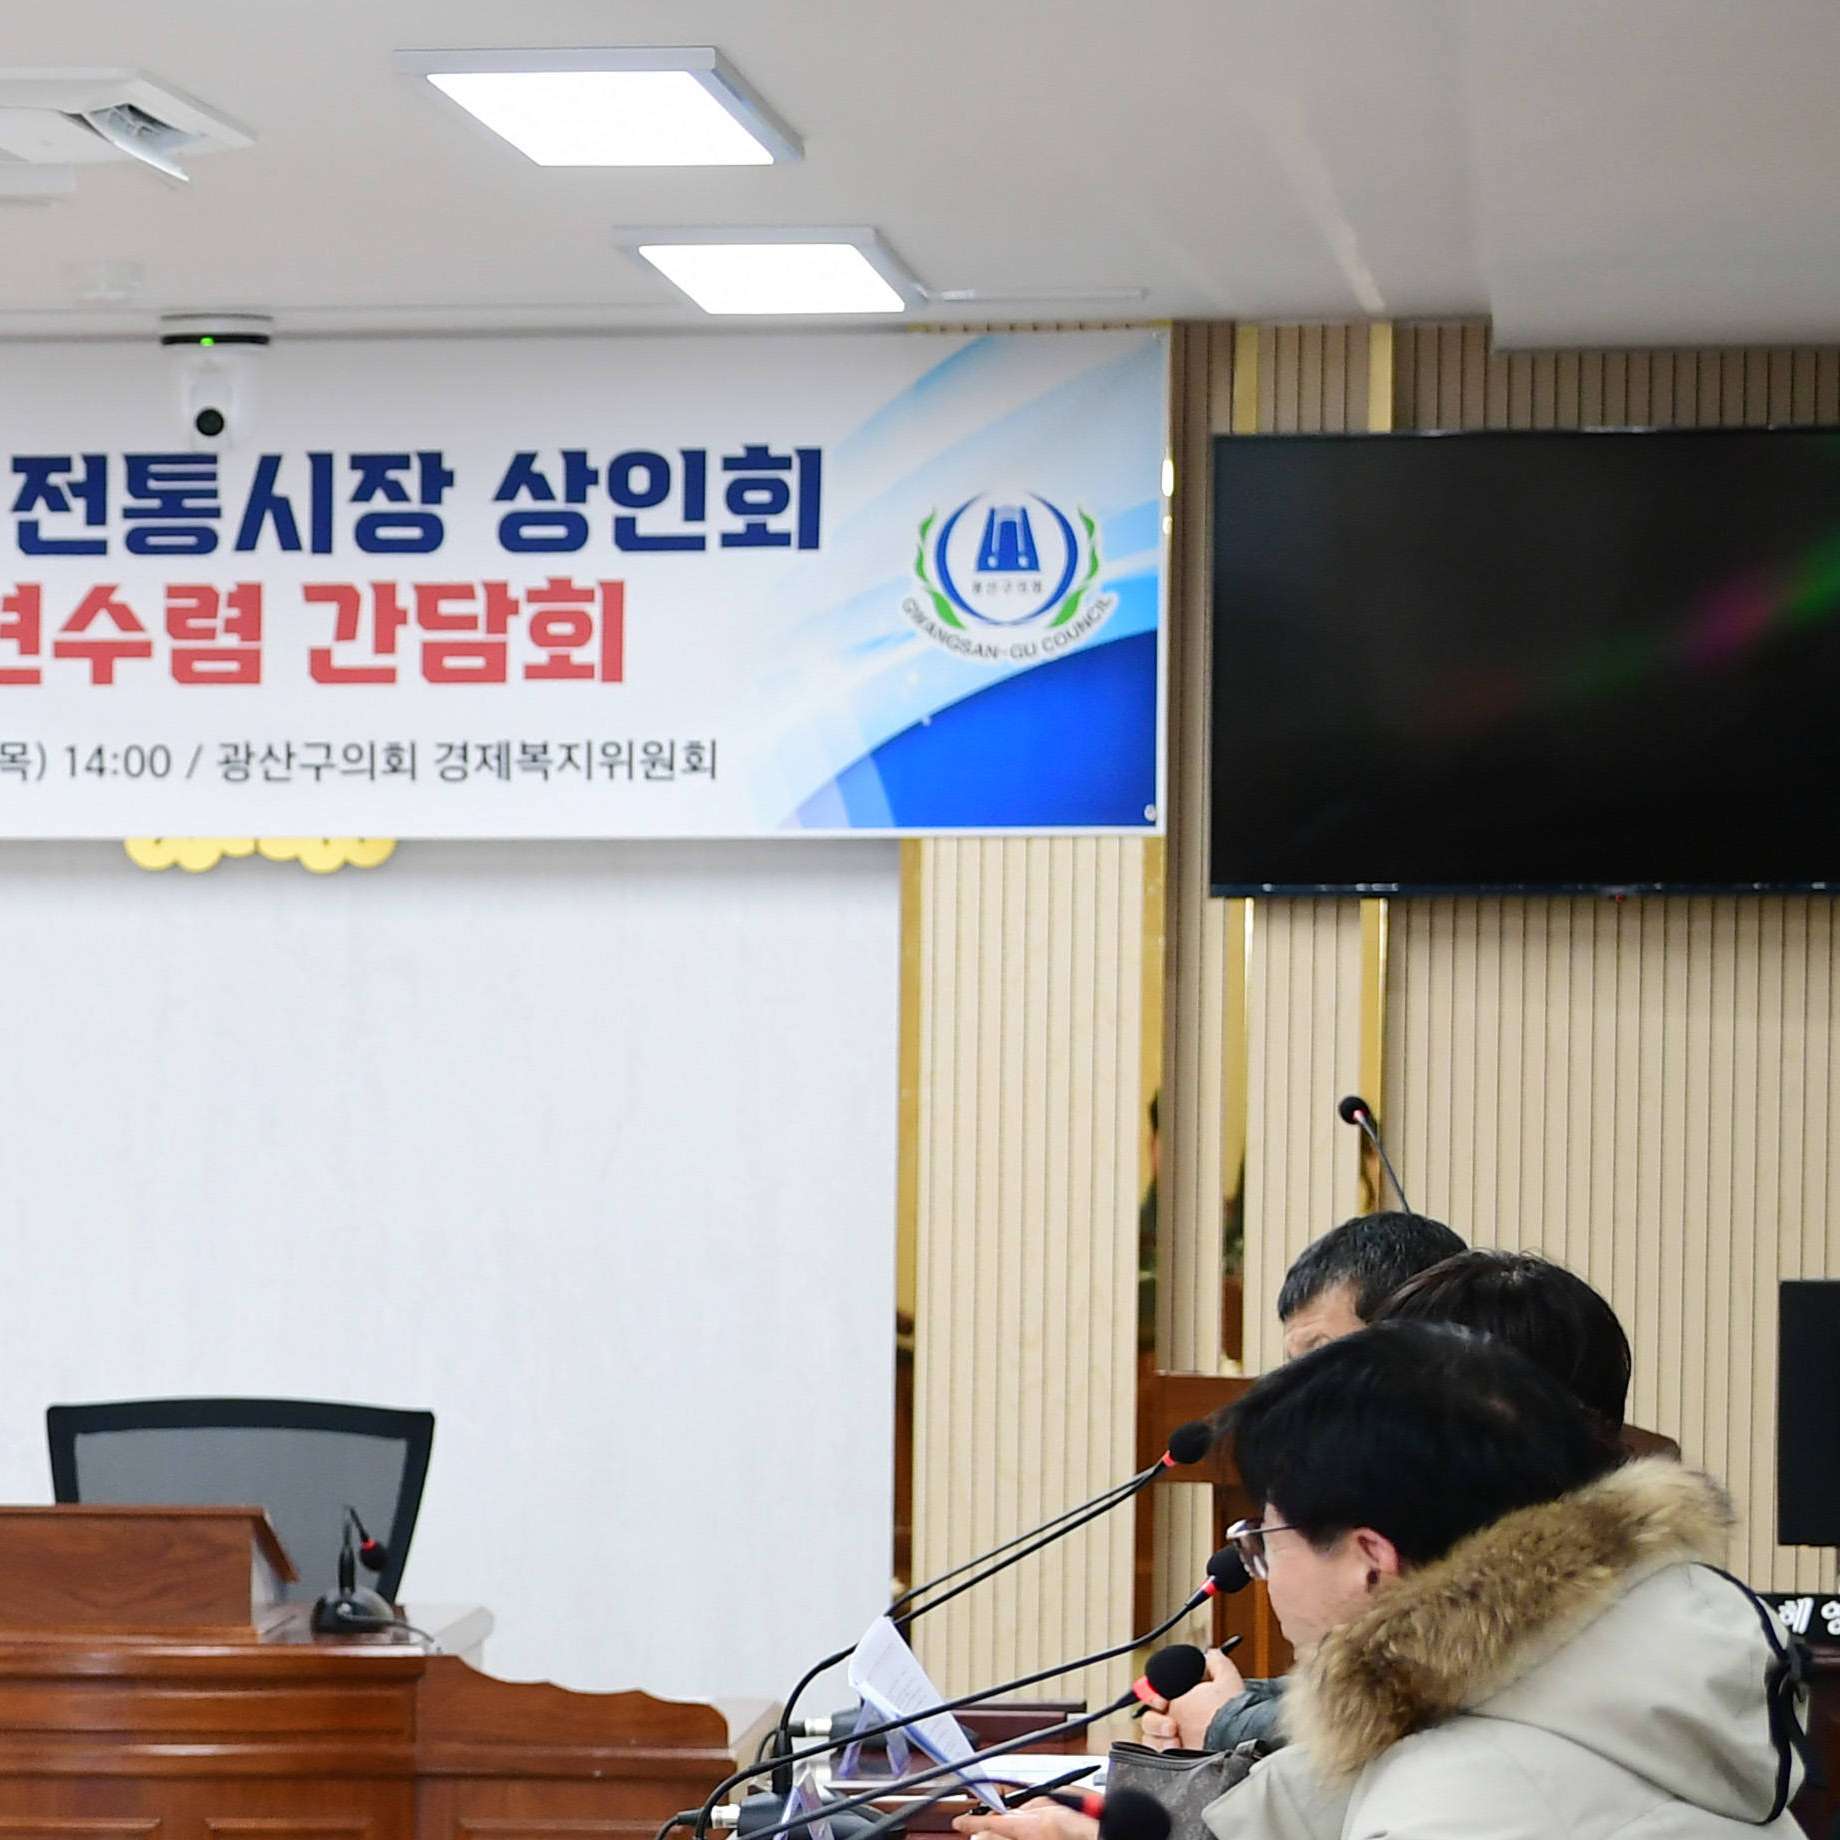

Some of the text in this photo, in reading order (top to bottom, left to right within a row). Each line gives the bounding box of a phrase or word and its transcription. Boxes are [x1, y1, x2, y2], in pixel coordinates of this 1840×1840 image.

[10, 451, 455, 556] 전통시장
[492, 445, 822, 553] 상인회
[302, 577, 625, 684] 간담회
[67, 742, 172, 780] 14:00
[217, 739, 418, 783] 광산구의회
[434, 738, 718, 783] 경제복지위원회
